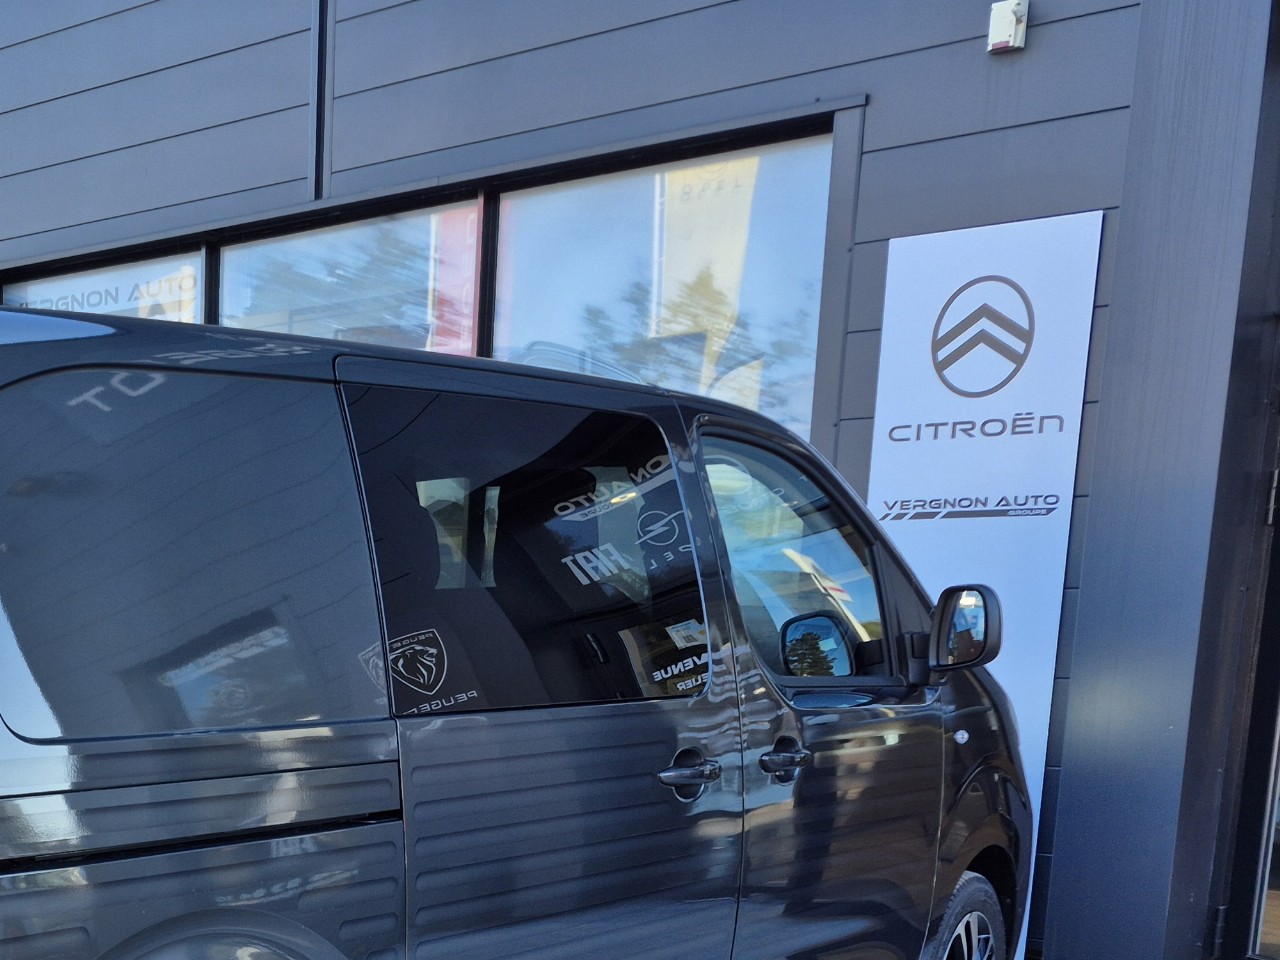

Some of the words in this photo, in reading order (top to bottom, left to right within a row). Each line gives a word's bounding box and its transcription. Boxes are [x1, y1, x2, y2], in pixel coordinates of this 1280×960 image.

[883, 496, 989, 511] VERGNON
[994, 493, 1061, 508] AUTO
[1007, 508, 1047, 517] GROUPE
